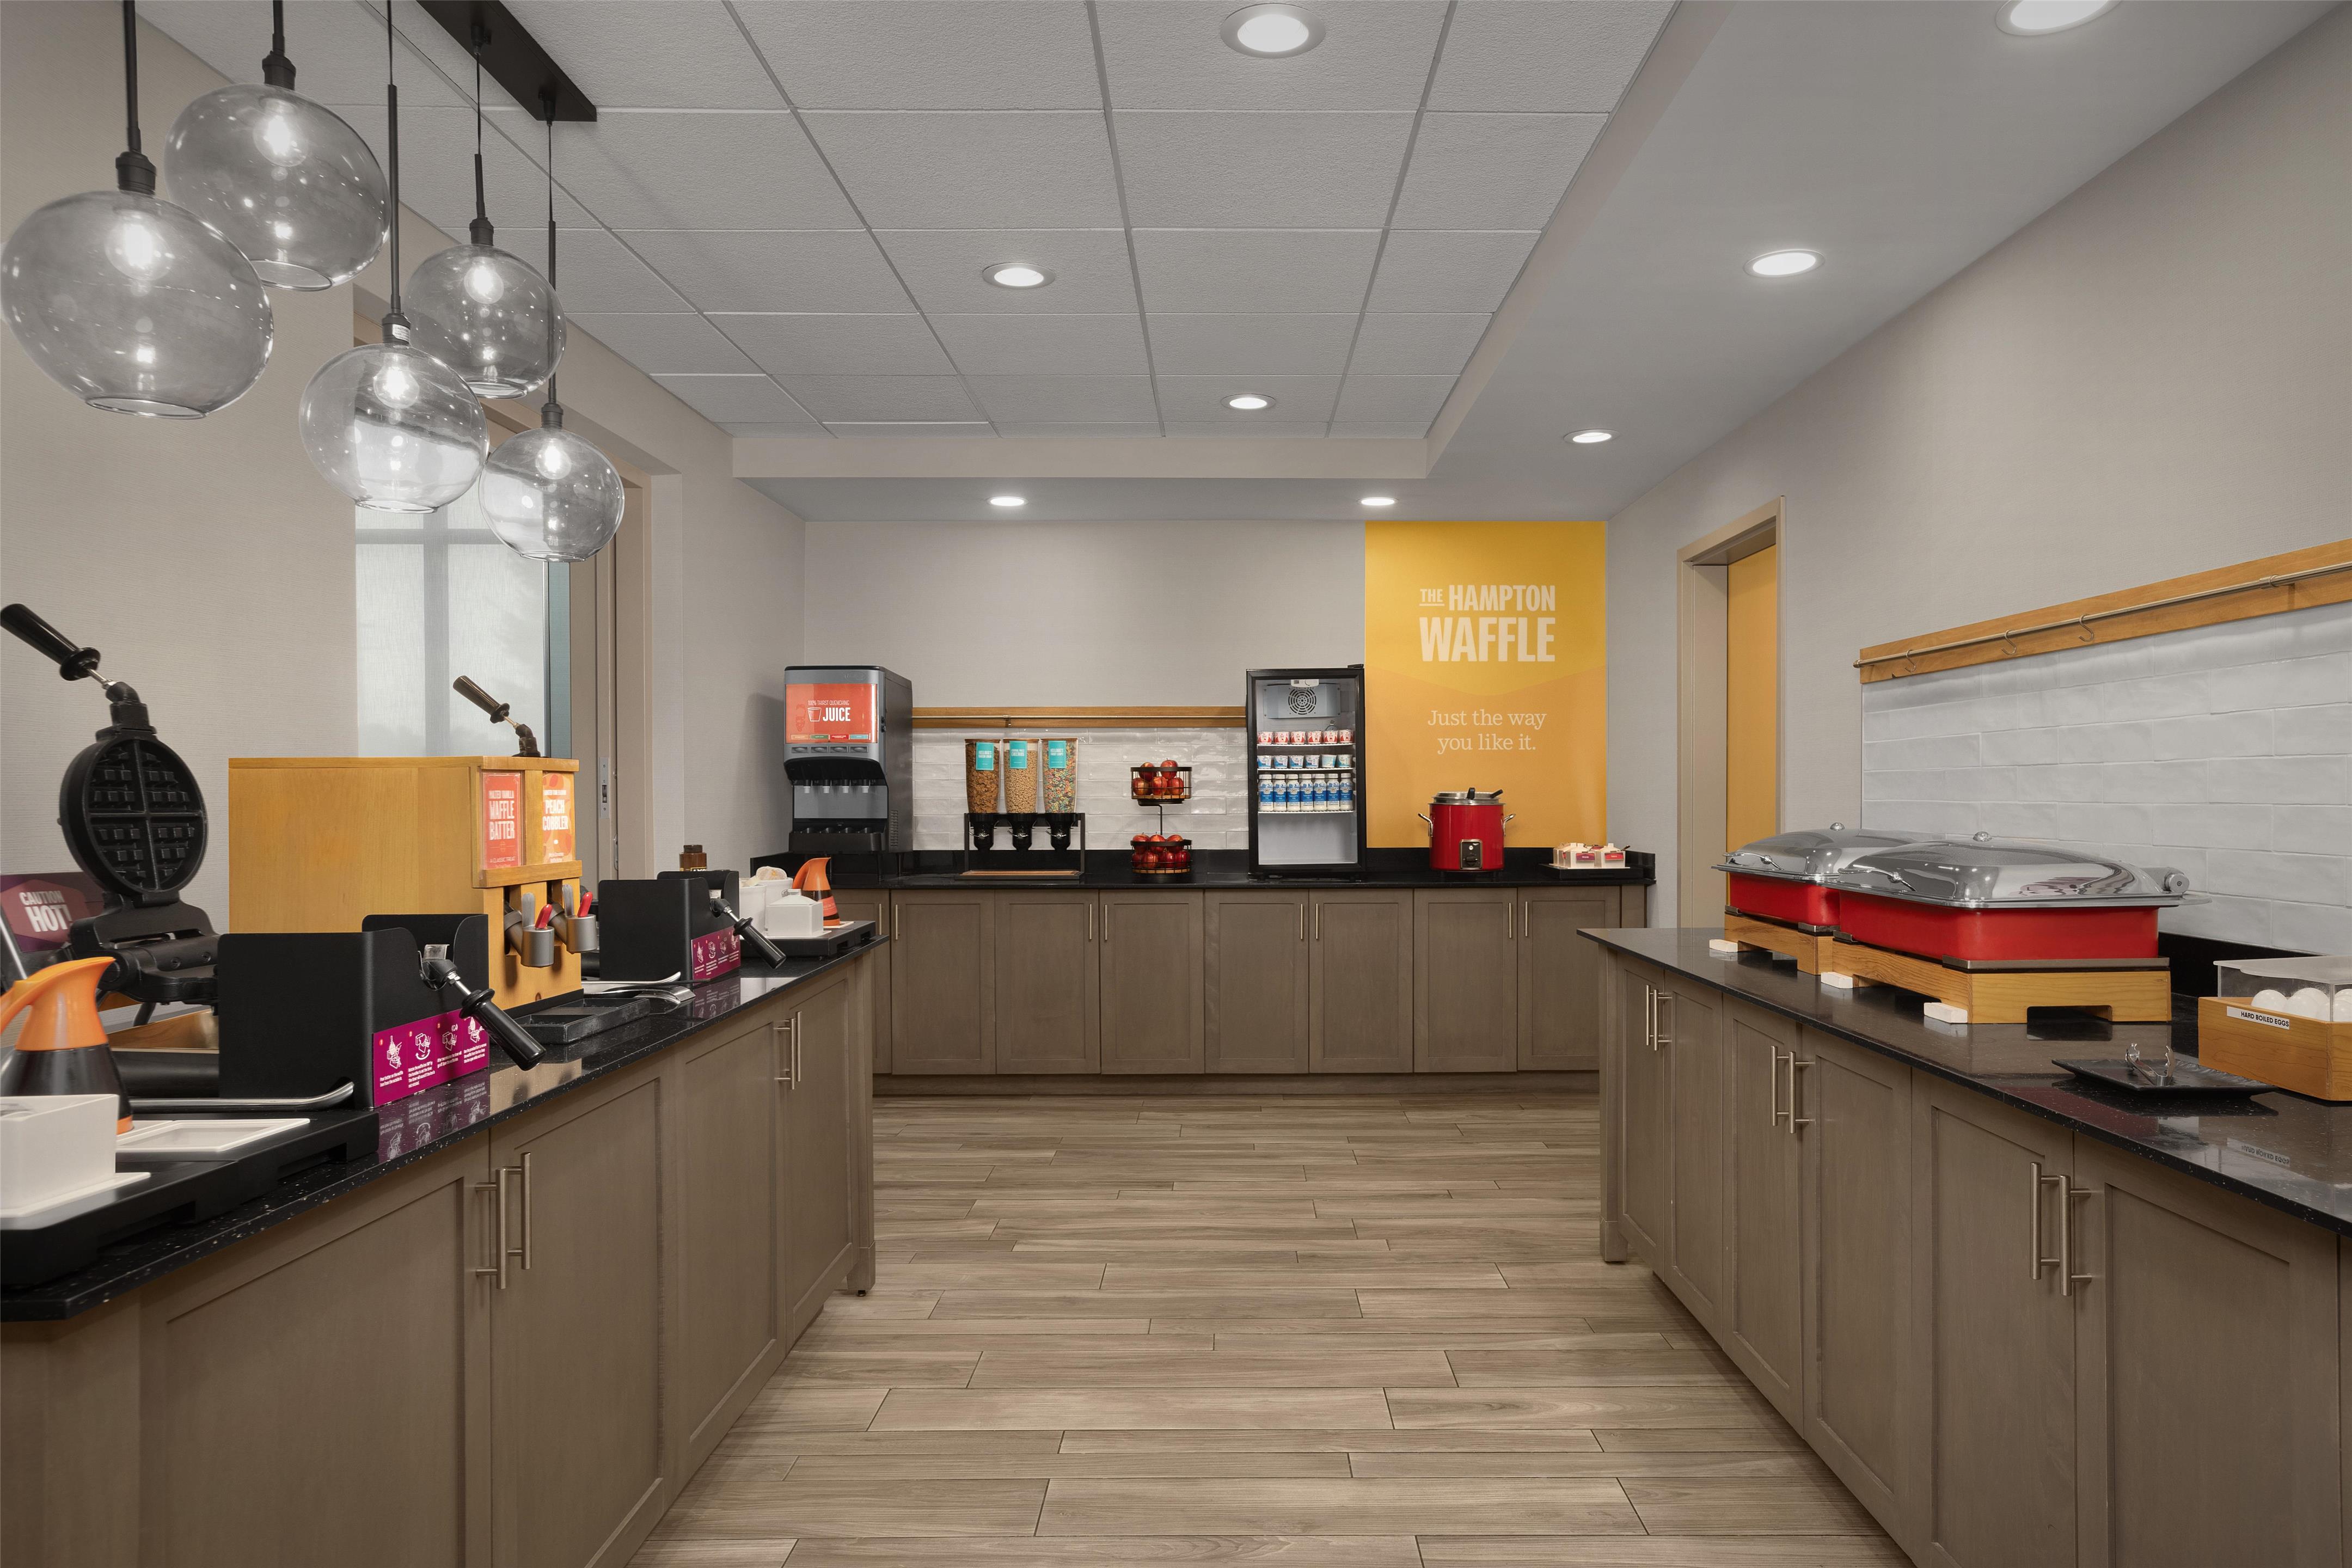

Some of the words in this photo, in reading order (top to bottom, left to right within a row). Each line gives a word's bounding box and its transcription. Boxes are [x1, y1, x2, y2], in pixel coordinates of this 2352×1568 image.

[1420, 589, 1443, 603] THE
[1449, 584, 1555, 611] HAMPTON
[1419, 617, 1555, 662] WAFFLE
[823, 707, 851, 722] JUICE
[1428, 709, 1467, 726] Just
[1472, 709, 1503, 726] the
[1508, 713, 1547, 730] way
[1437, 737, 1474, 755] you
[1478, 733, 1513, 750] like
[1518, 733, 1536, 750] it.
[489, 800, 514, 819] WAFFLE
[546, 799, 565, 814] PEACH
[489, 820, 515, 840] BATTER
[542, 816, 568, 831] COBBLER
[19, 890, 65, 905] CAUTION
[24, 904, 73, 932] HOT!
[2240, 1011, 2255, 1020] HARD
[2256, 1014, 2273, 1024] BOILED
[2274, 1018, 2289, 1027] EGGS
